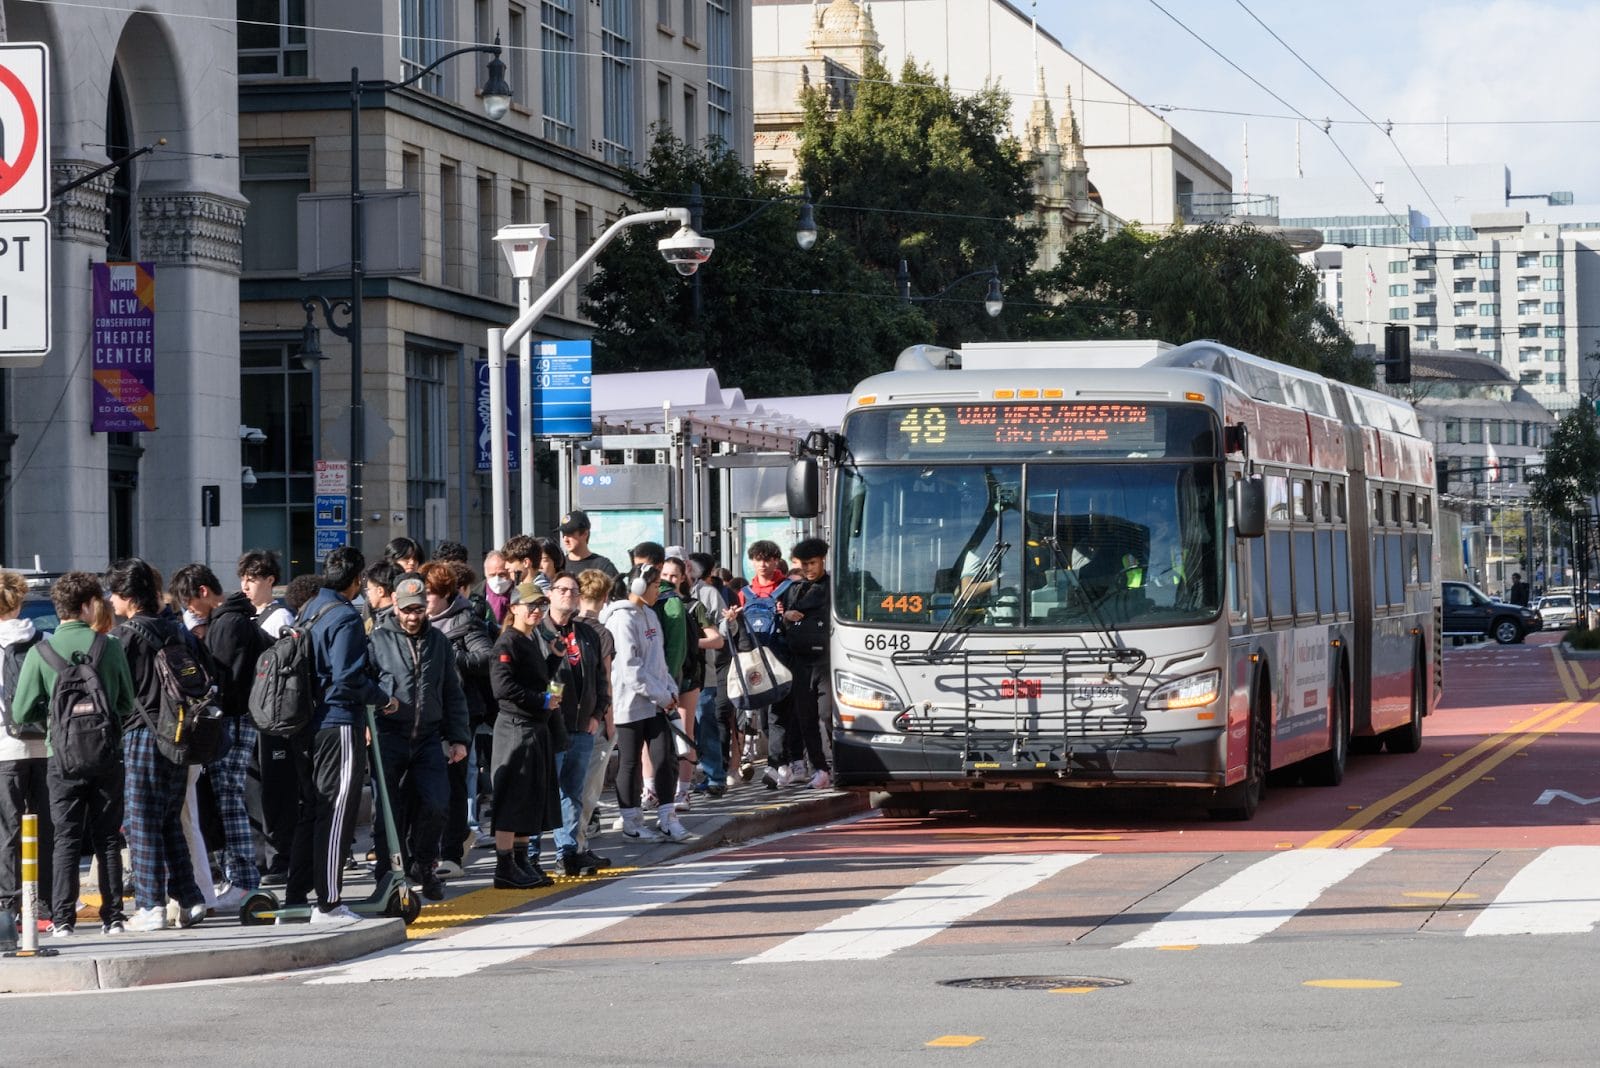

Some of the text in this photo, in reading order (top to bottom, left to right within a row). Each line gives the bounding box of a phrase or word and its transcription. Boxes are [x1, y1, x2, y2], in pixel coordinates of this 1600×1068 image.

[110, 299, 137, 314] NEW
[95, 318, 152, 328] CONSERVATORY
[96, 331, 152, 344] THEATRE
[96, 348, 152, 364] CENTER
[535, 359, 550, 372] 49
[536, 374, 550, 387] 90
[582, 476, 612, 485] 49 90
[318, 498, 329, 506] Pay
[881, 595, 922, 613] 443
[864, 634, 911, 650] 6648
